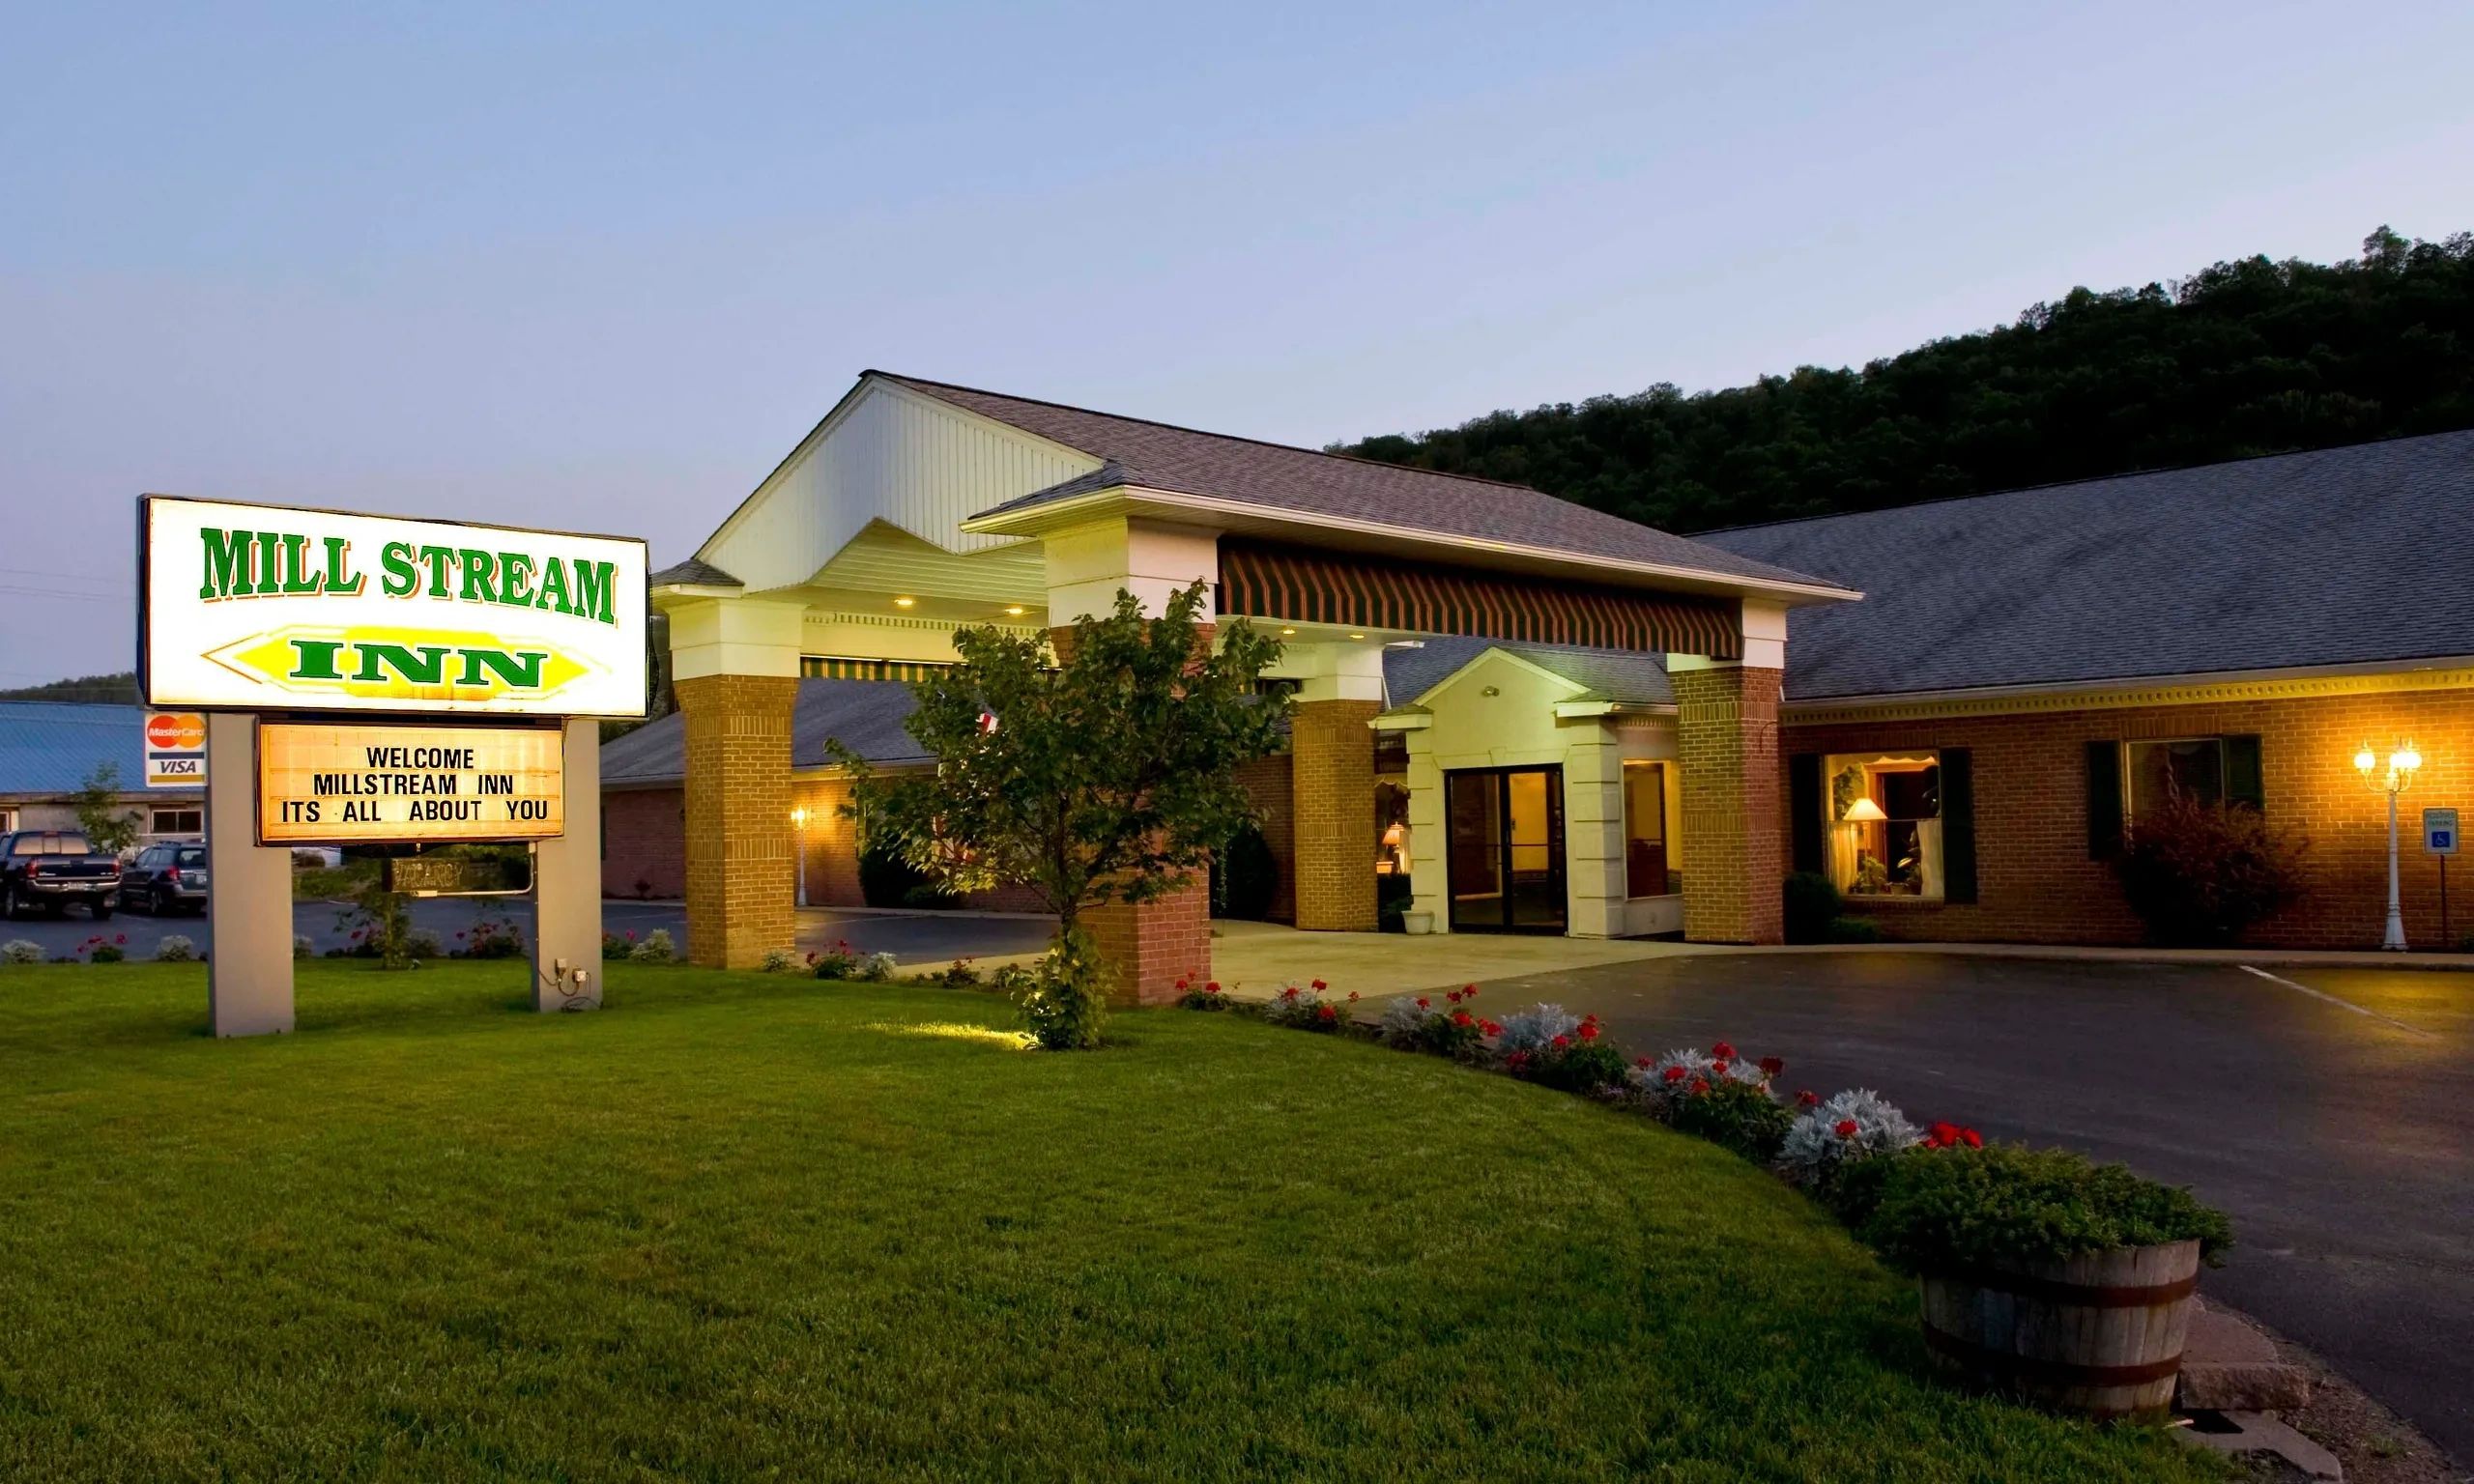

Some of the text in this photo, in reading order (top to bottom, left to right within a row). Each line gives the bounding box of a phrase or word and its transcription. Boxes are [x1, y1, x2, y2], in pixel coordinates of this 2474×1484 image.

[199, 528, 618, 628] MILL STREAM
[290, 640, 548, 688] INN
[159, 760, 196, 774] VISA
[366, 747, 475, 769] WELCOME
[313, 774, 513, 796] MILLSTREAM INN
[282, 799, 548, 823] ITS ALL ABOUT YOU
